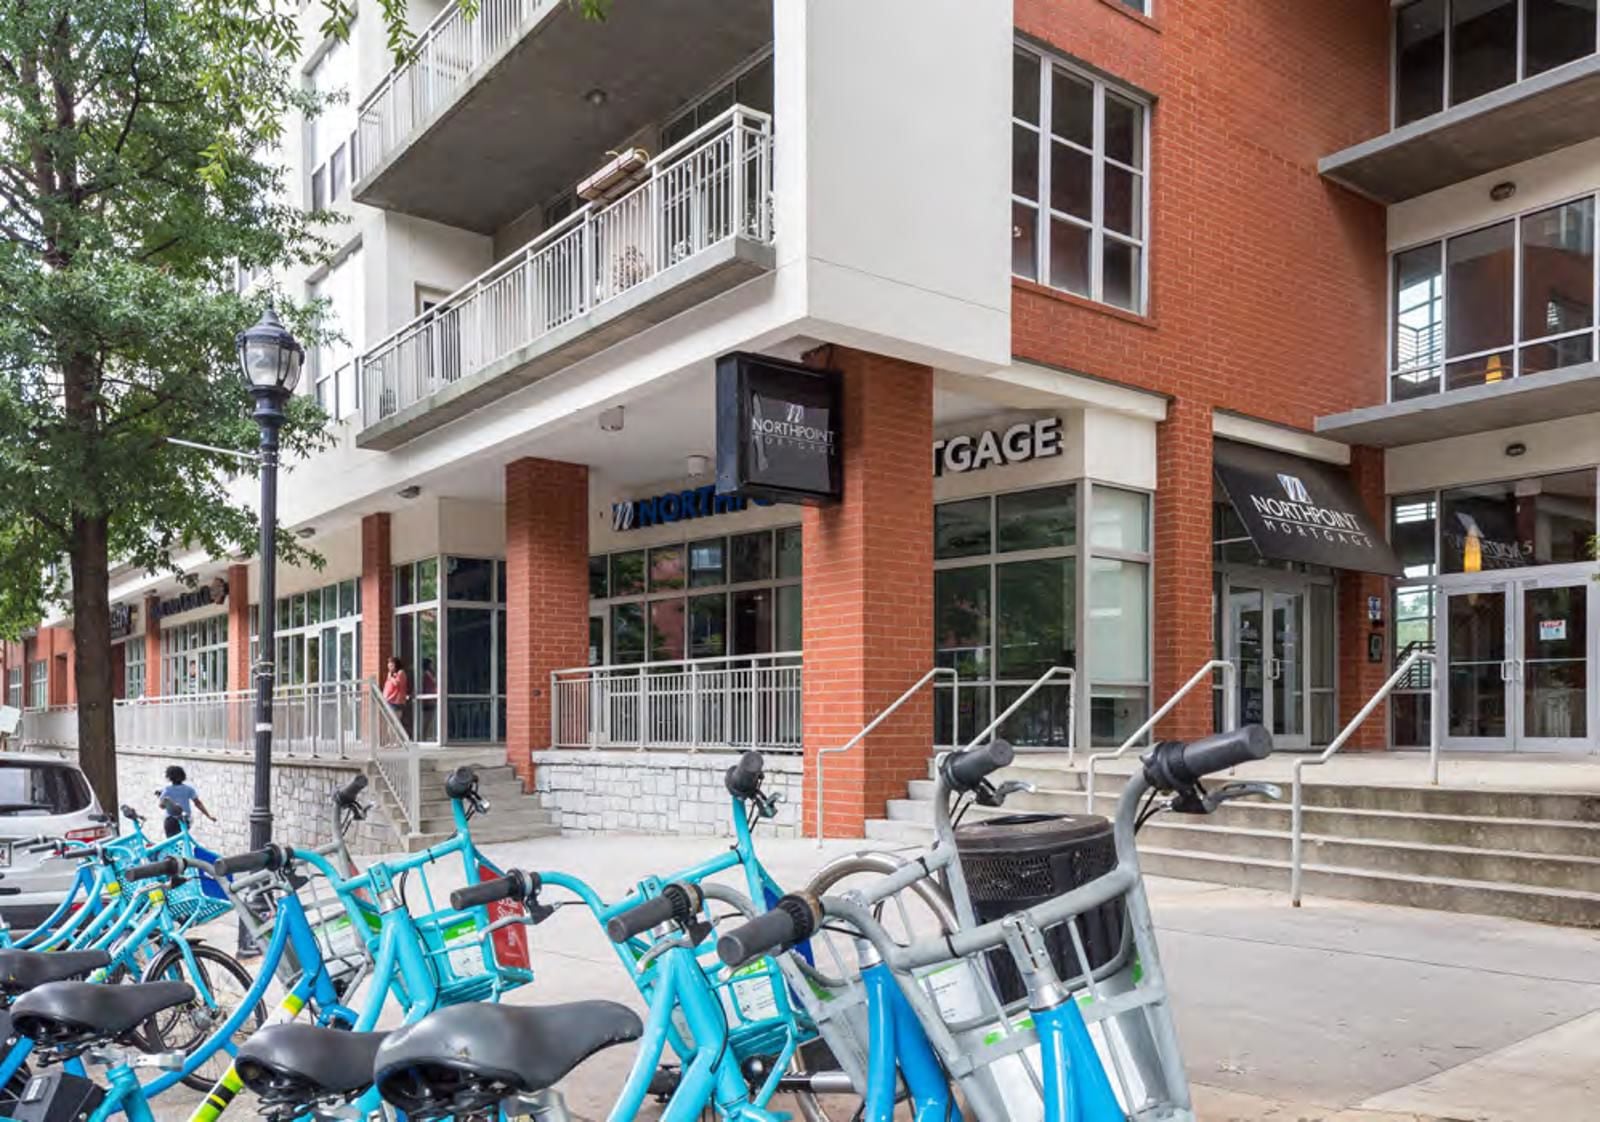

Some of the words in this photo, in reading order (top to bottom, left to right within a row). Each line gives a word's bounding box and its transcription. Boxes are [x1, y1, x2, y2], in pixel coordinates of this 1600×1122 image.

[751, 417, 834, 443] NORTHPOINT
[1250, 494, 1360, 531] NORTHPOINT
[1264, 519, 1373, 548] MORTGAGE
